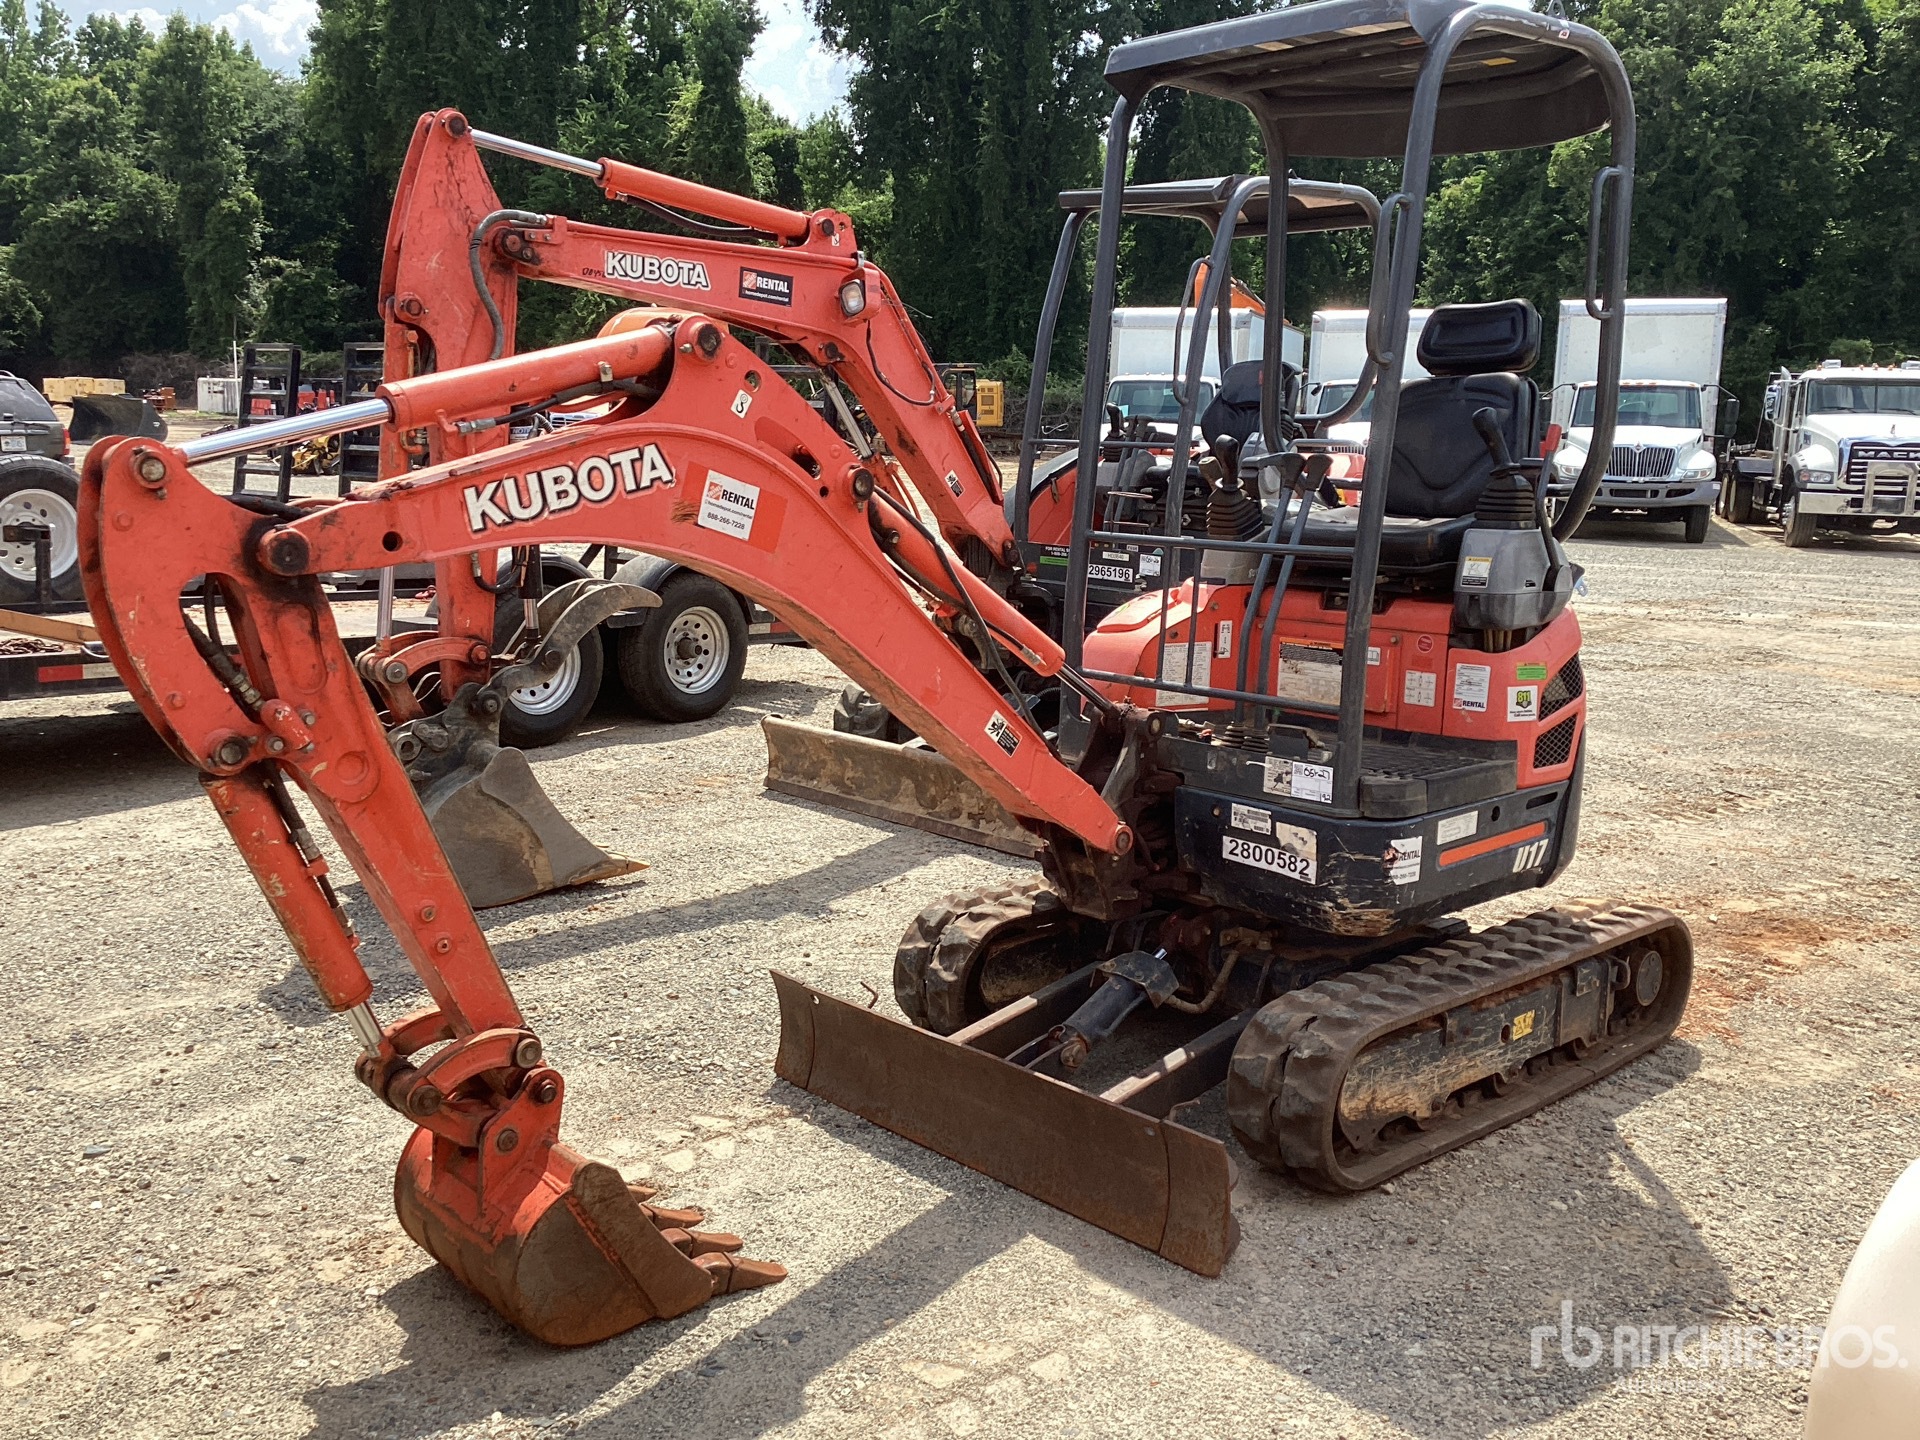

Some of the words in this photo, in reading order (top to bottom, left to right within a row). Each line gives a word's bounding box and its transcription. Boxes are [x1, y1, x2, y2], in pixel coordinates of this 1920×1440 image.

[606, 250, 710, 289] KUBOTA
[756, 276, 790, 293] RENTAL
[1857, 450, 1920, 459] MACK
[462, 442, 675, 533] KUBOTA
[721, 488, 755, 510] RENTAL
[1088, 565, 1130, 579] 2965196
[1462, 700, 1486, 709] RENTAL
[1516, 690, 1532, 703] 811
[1228, 839, 1310, 877] 2800582
[1512, 838, 1549, 873] U17
